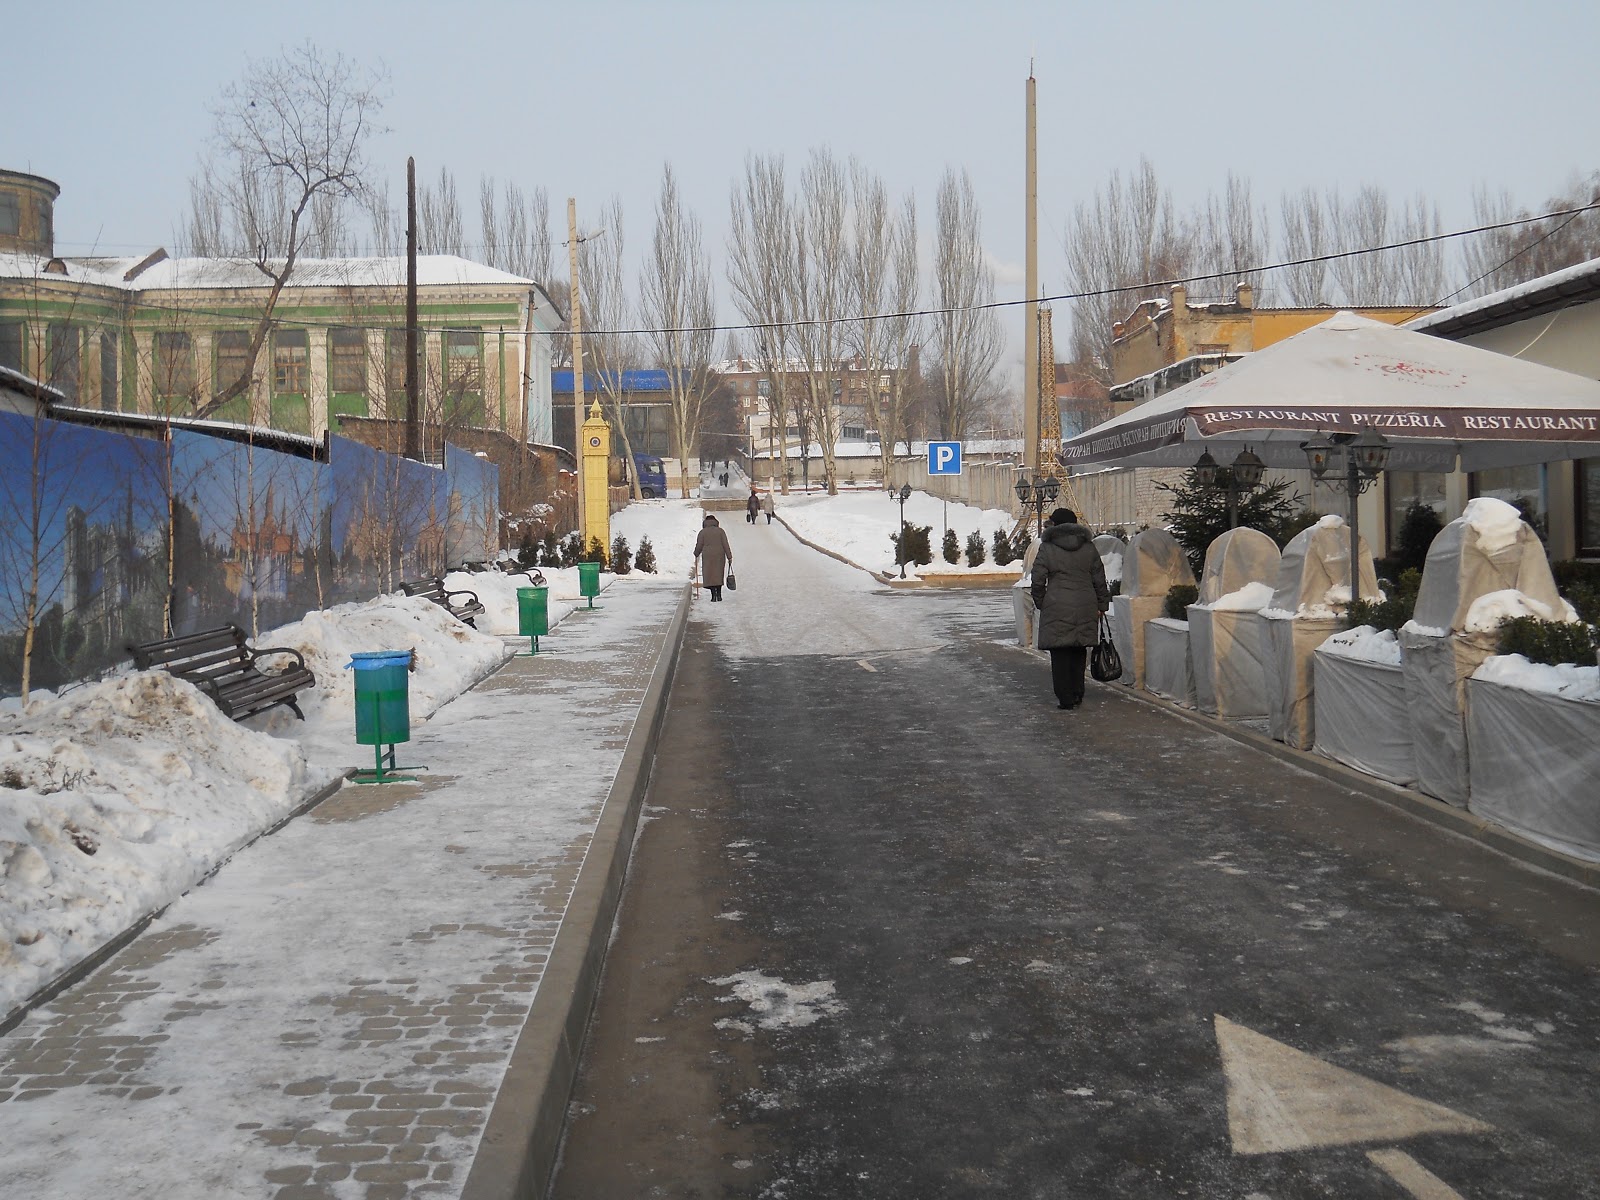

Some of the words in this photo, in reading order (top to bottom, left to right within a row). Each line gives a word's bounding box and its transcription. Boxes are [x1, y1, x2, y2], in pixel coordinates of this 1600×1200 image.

[1204, 411, 1340, 424] RESTAURANT
[1350, 413, 1446, 428] PIZZERIA
[1462, 416, 1597, 430] RESTAURANT
[1123, 427, 1148, 446] РЕСТОРАН
[937, 446, 954, 471] P
